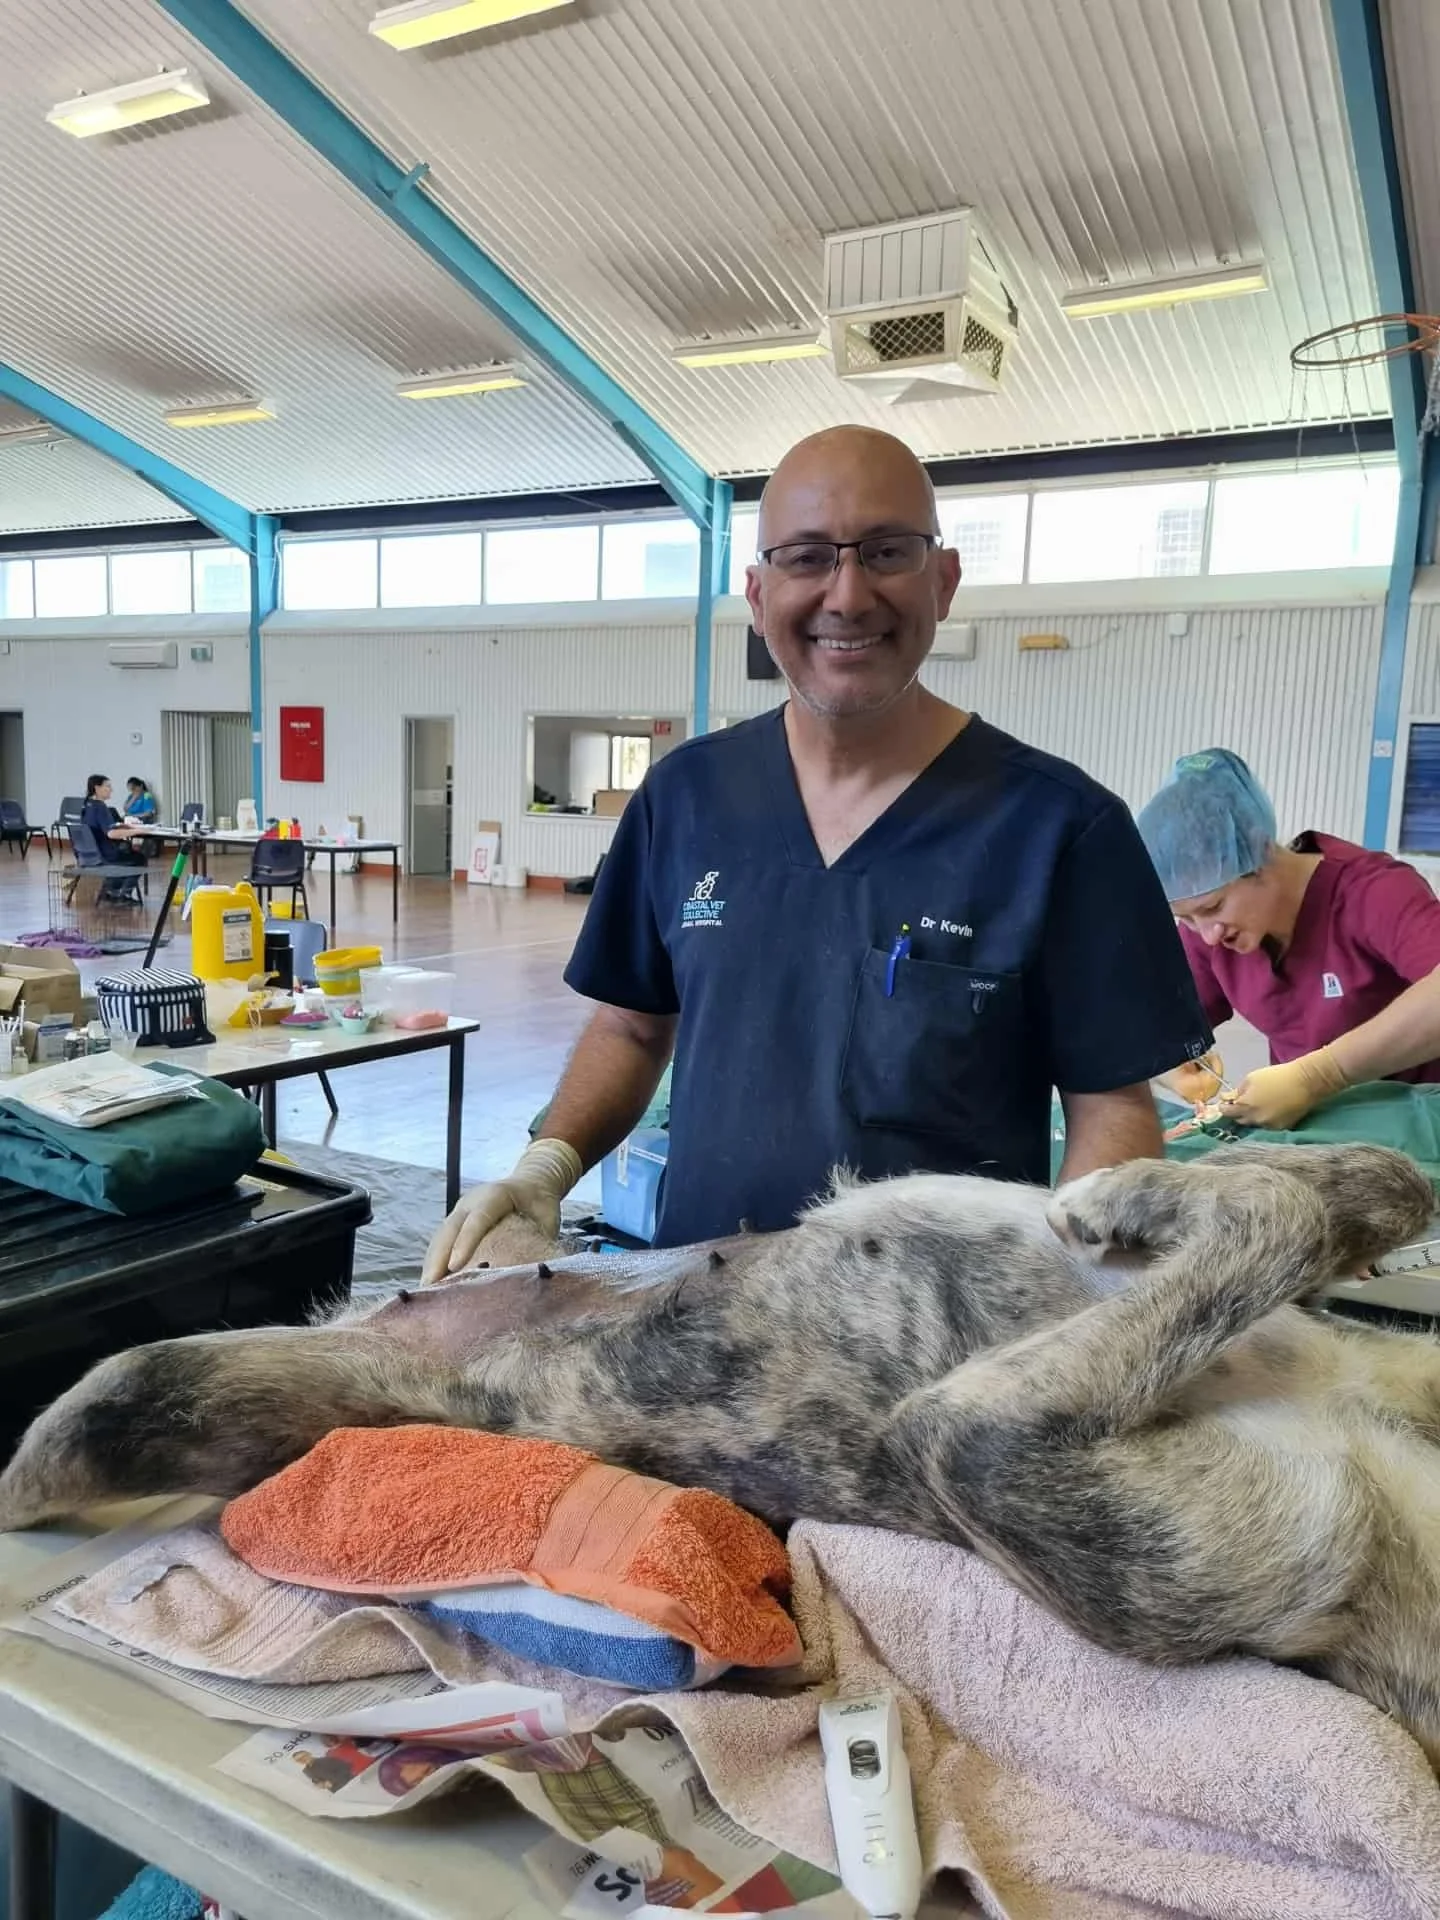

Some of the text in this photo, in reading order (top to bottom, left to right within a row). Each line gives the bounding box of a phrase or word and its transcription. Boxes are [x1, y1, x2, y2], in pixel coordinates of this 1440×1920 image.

[710, 900, 726, 911] VET
[920, 916, 974, 937] Dr Kevin
[37, 1574, 87, 1603] OPINION
